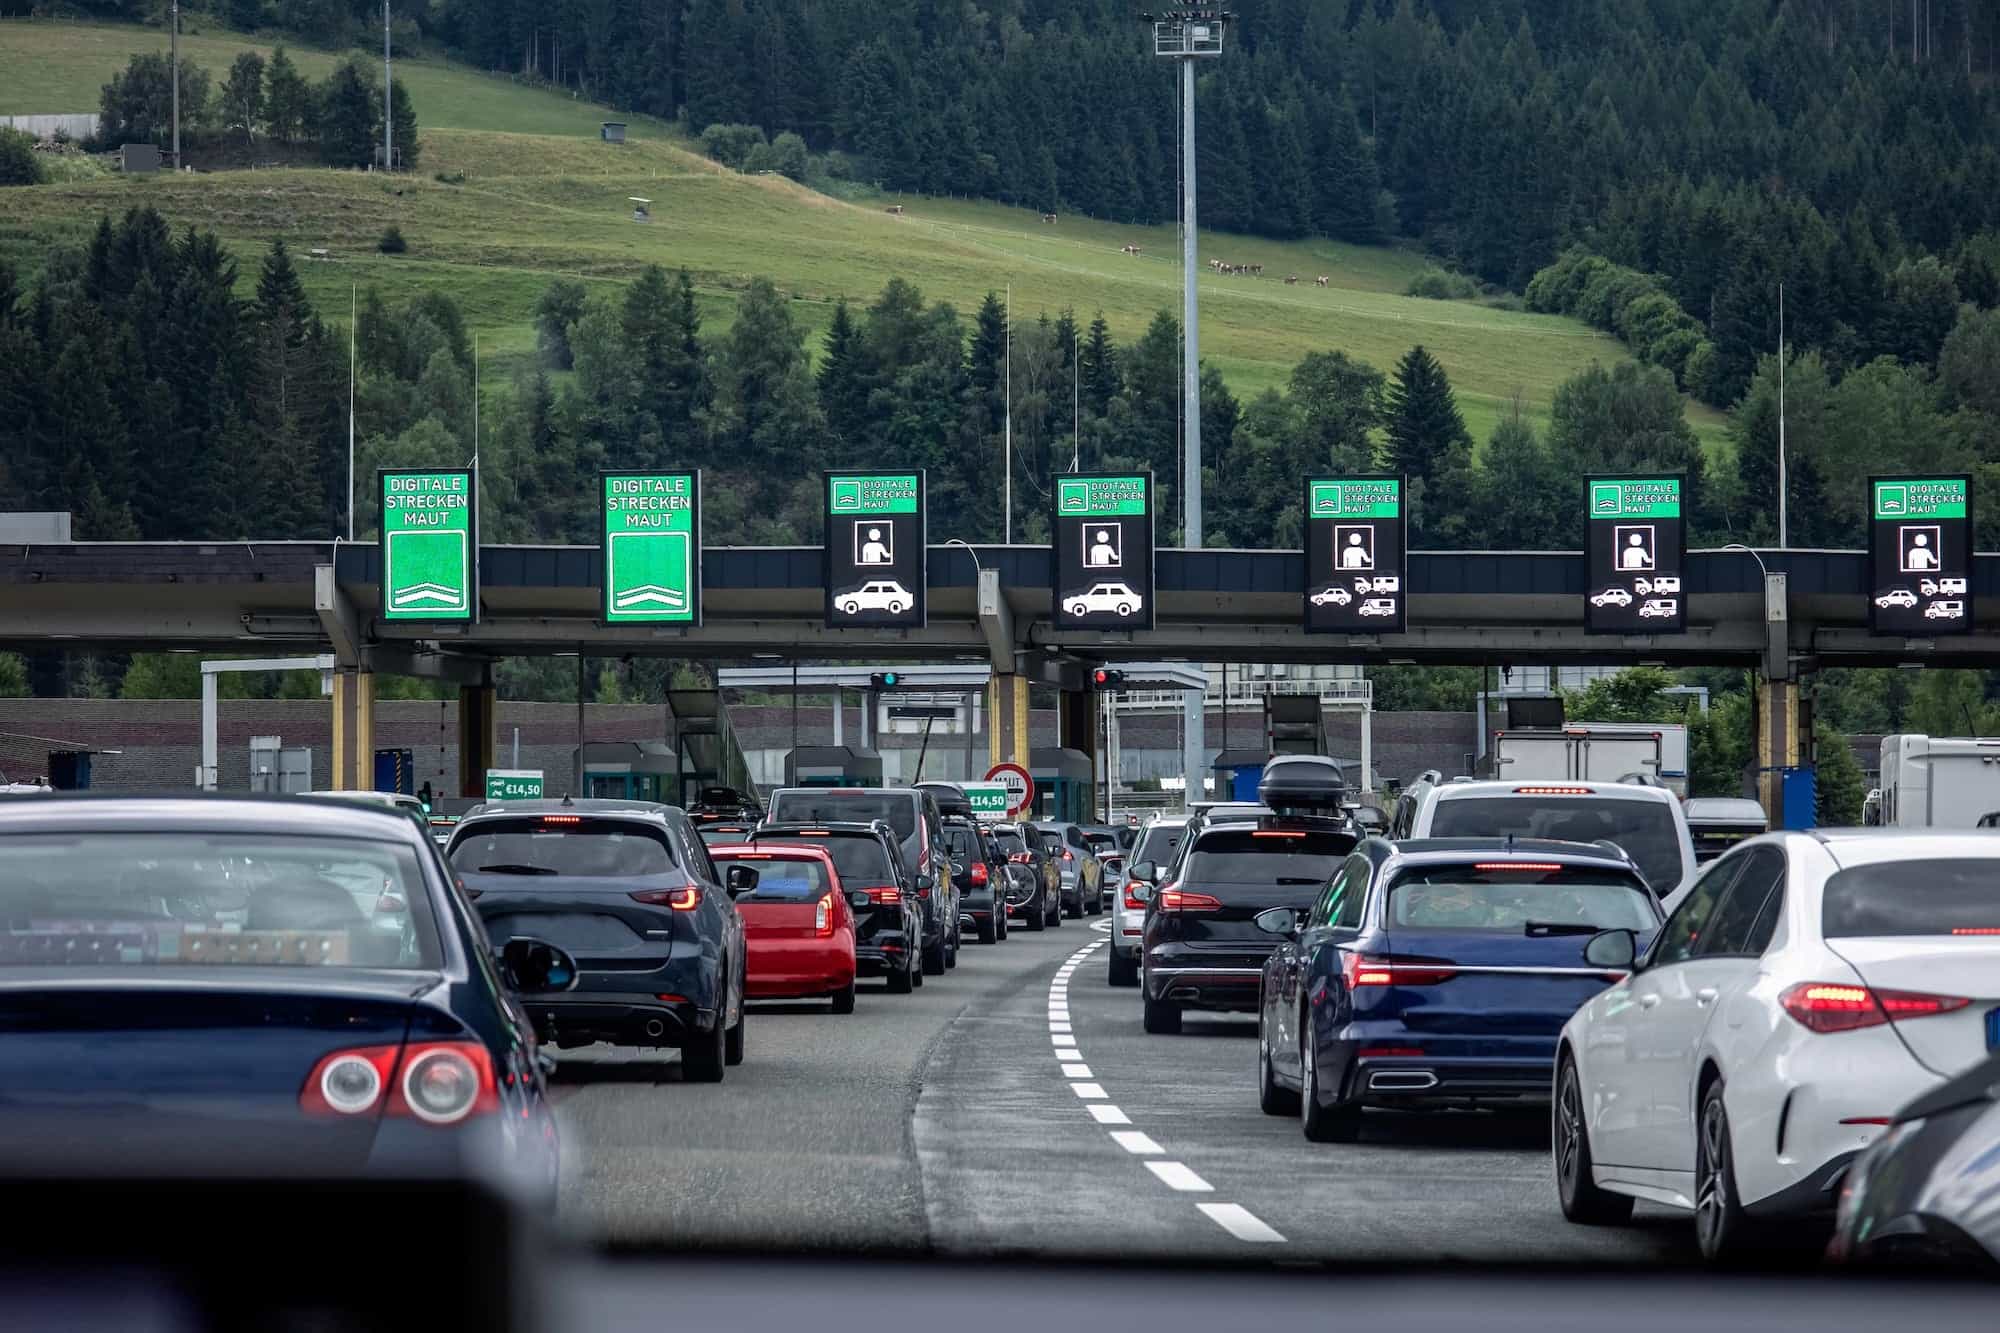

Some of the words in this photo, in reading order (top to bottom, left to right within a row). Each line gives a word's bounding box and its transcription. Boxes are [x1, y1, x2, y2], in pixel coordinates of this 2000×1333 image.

[391, 478, 462, 492] DIGITALE
[612, 480, 684, 493] DIGITALE
[864, 480, 911, 488] DIGITALE
[1624, 484, 1672, 492] DIGITALE
[1910, 484, 1958, 492] DIGITALE
[864, 490, 916, 498] STRECKEN
[386, 495, 467, 508] STRECKEN
[608, 496, 690, 510] STRECKEN
[404, 512, 449, 525] MAUT
[626, 514, 672, 527] MAUT
[506, 784, 540, 796] €14,50
[970, 796, 1004, 808] €14,50
